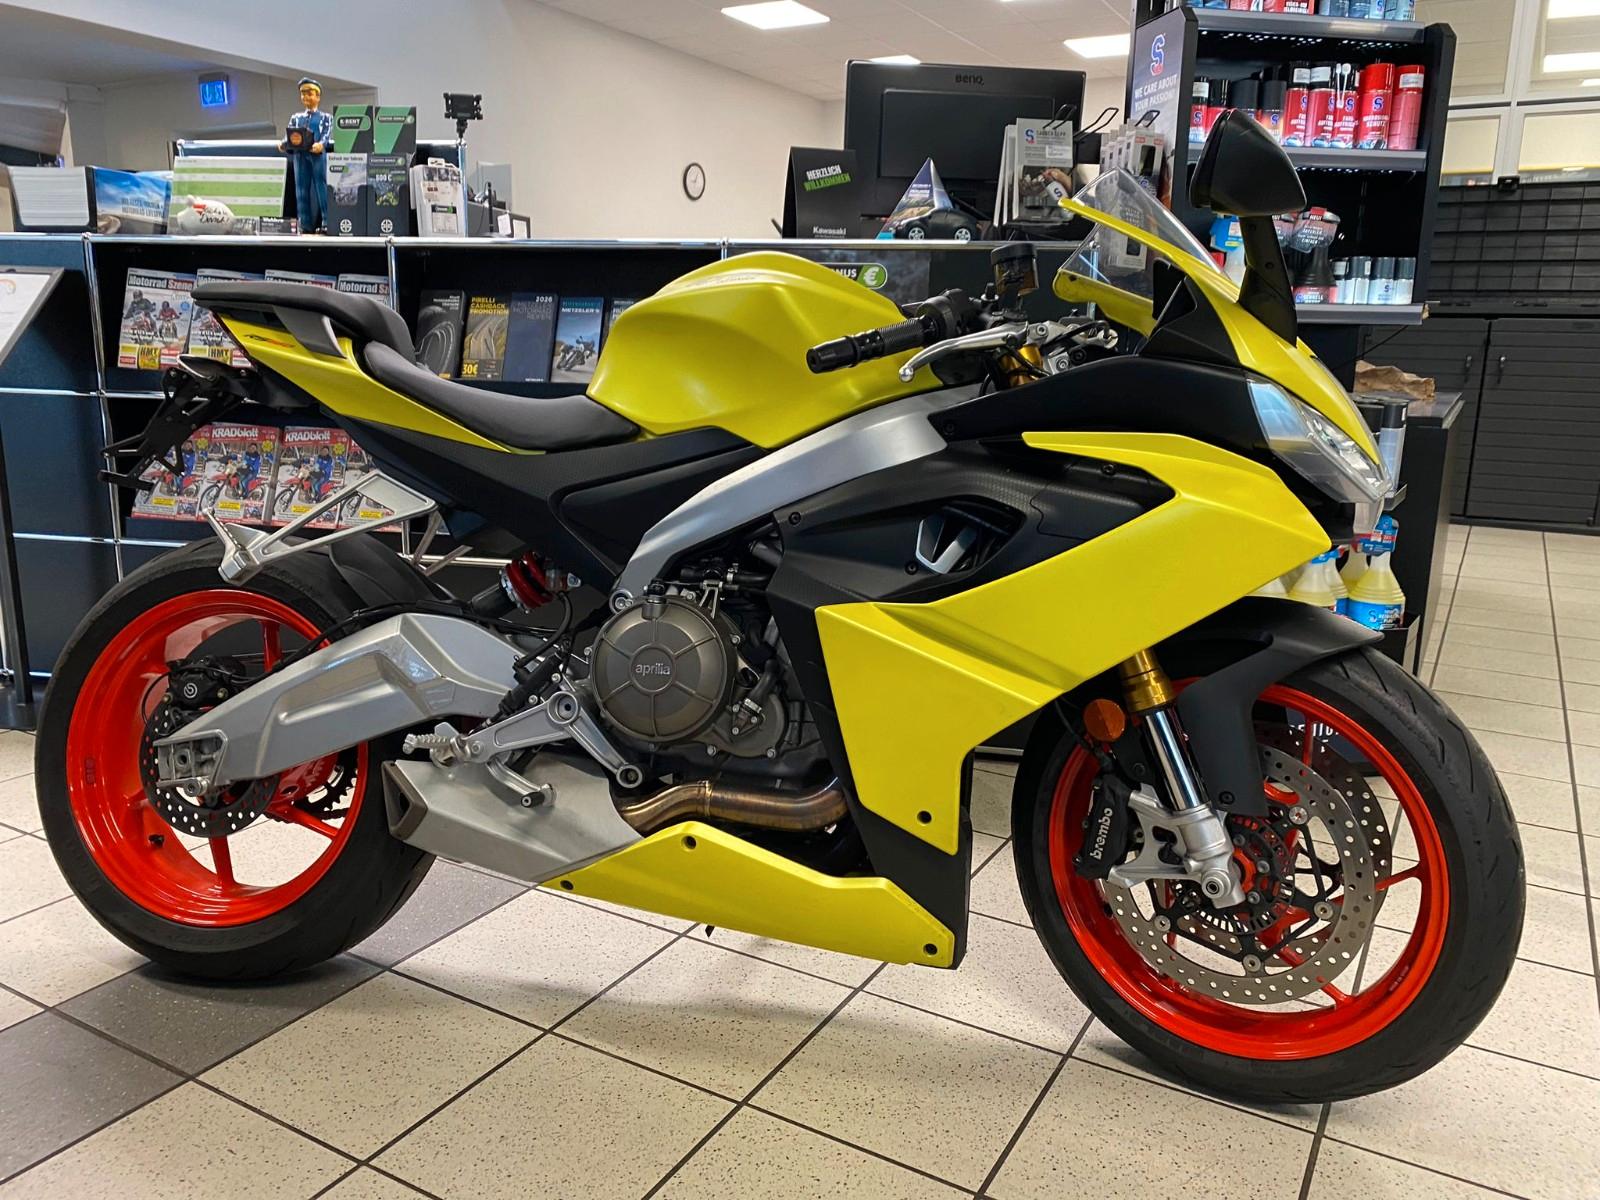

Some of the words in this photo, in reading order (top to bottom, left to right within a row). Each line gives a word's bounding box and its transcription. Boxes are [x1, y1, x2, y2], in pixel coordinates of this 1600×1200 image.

[955, 73, 985, 85] BenQ
[1135, 87, 1143, 99] WE
[1144, 81, 1158, 96] CARE
[1158, 73, 1178, 90] ABOUT
[806, 164, 842, 180] HERZLICH
[803, 172, 851, 191] WILLKOMMEN
[812, 226, 847, 236] Kawasaki
[128, 274, 168, 289] Motorrad
[168, 279, 194, 291] Szene
[340, 281, 378, 294] Motorrad
[469, 308, 509, 316] PROMOTION
[140, 346, 159, 356] HMT
[211, 347, 230, 357] HMT
[462, 363, 478, 375] 30€
[212, 427, 259, 438] KRADblatt
[285, 431, 331, 442] KRADblatt
[635, 662, 671, 677] aprilia
[1090, 807, 1113, 860] brembo
